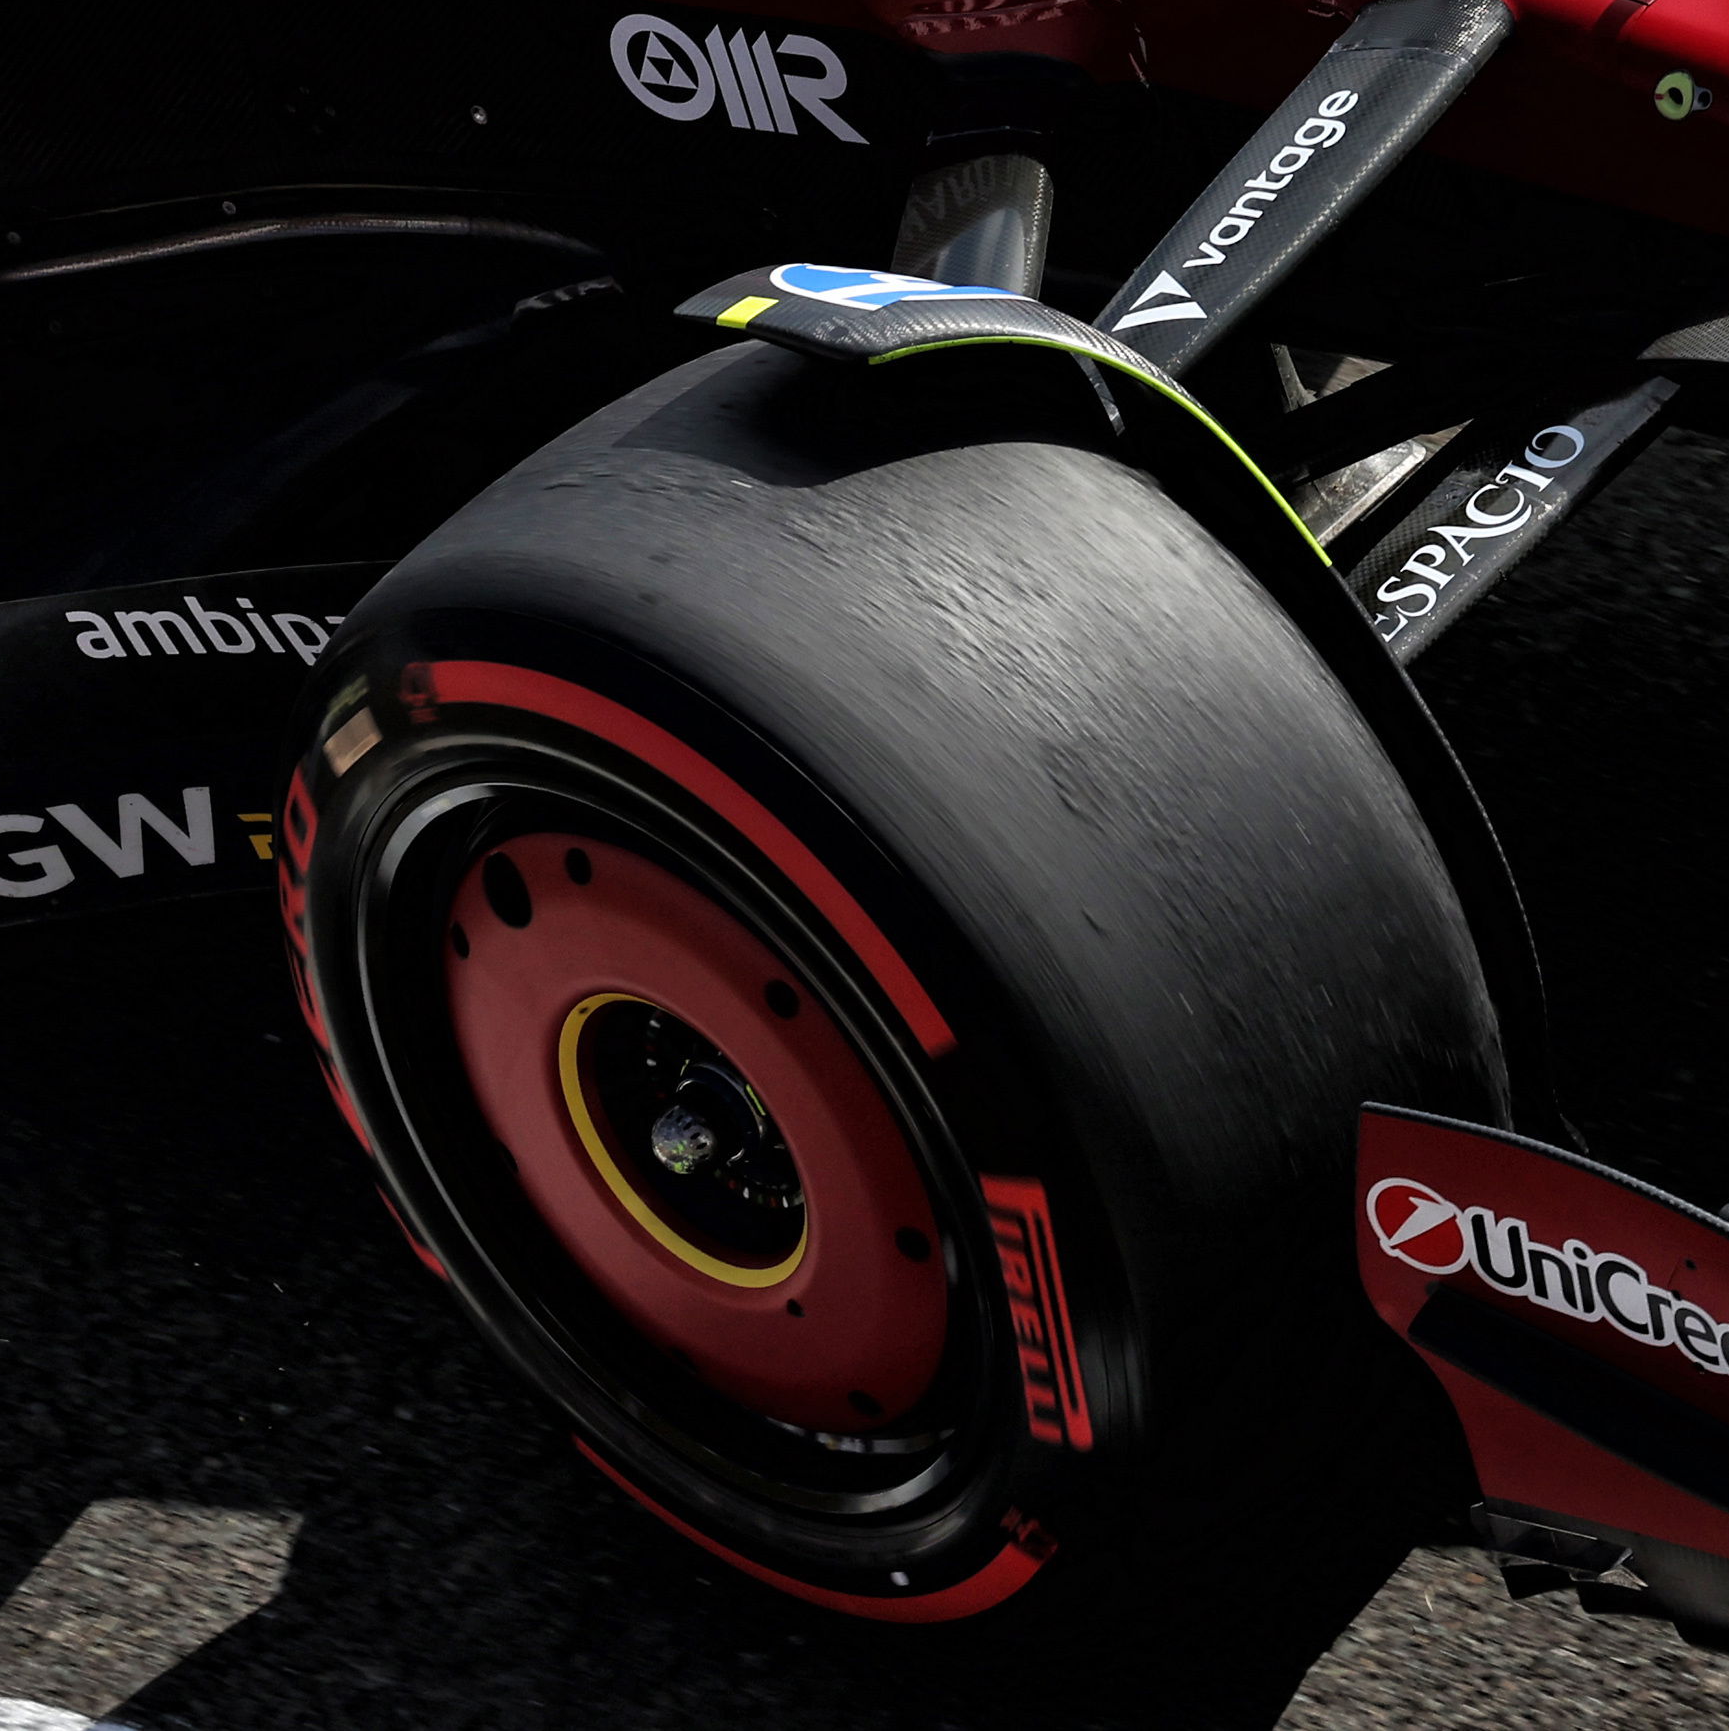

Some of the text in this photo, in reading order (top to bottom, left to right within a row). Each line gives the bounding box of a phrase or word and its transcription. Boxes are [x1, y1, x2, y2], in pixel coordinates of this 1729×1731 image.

[1182, 89, 1359, 269] vantage
[65, 595, 345, 667] ambip
[979, 1172, 1093, 1452] PIRELLI
